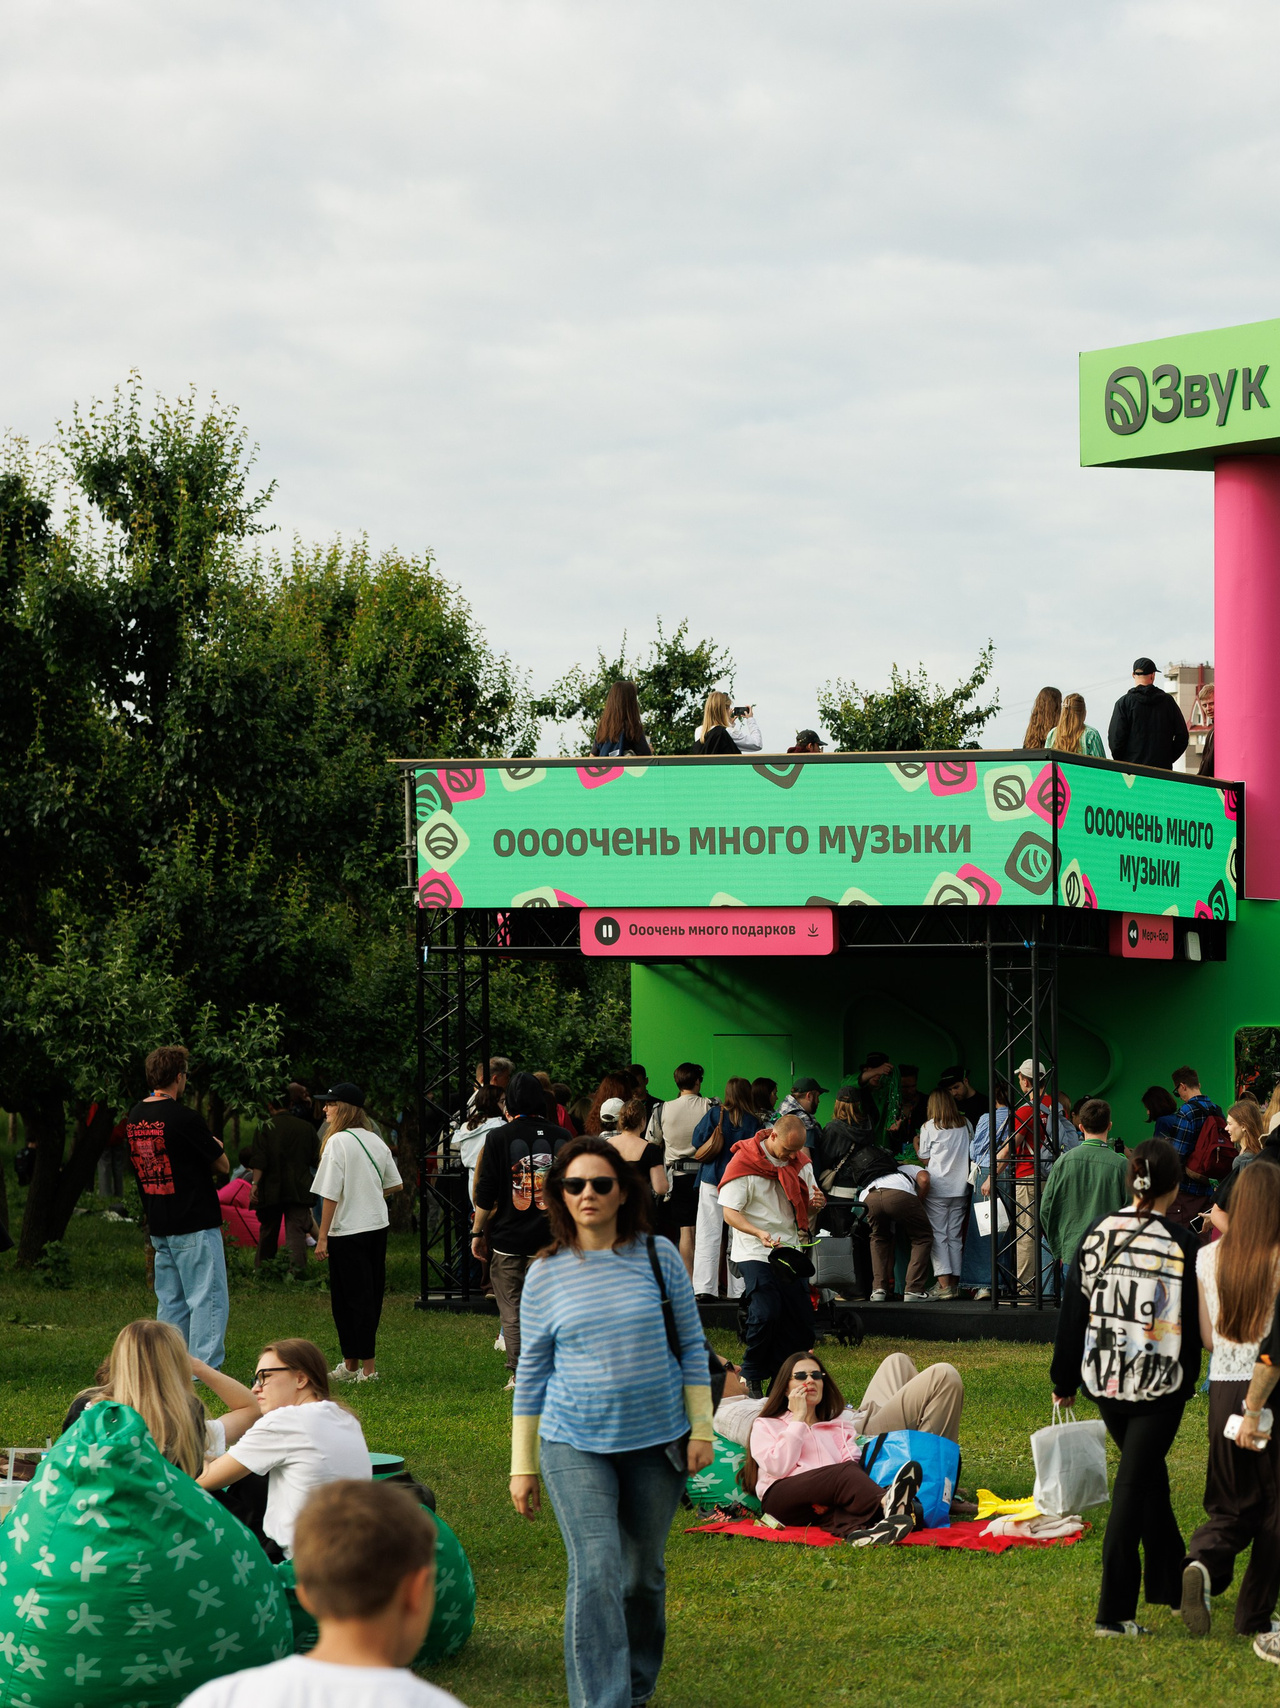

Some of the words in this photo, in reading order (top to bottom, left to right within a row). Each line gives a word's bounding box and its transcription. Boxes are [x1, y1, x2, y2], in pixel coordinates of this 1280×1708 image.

[1151, 364, 1270, 427] Звук
[493, 827, 681, 857] оооочень
[689, 826, 809, 855] много
[818, 824, 971, 863] музыки
[1084, 805, 1163, 844] оооочень
[1166, 817, 1214, 850] много
[1119, 854, 1180, 892] музыки
[628, 923, 686, 936] Ооочень
[688, 923, 729, 936] много
[731, 922, 796, 938] подарков
[1141, 928, 1169, 944] Мерч-бар
